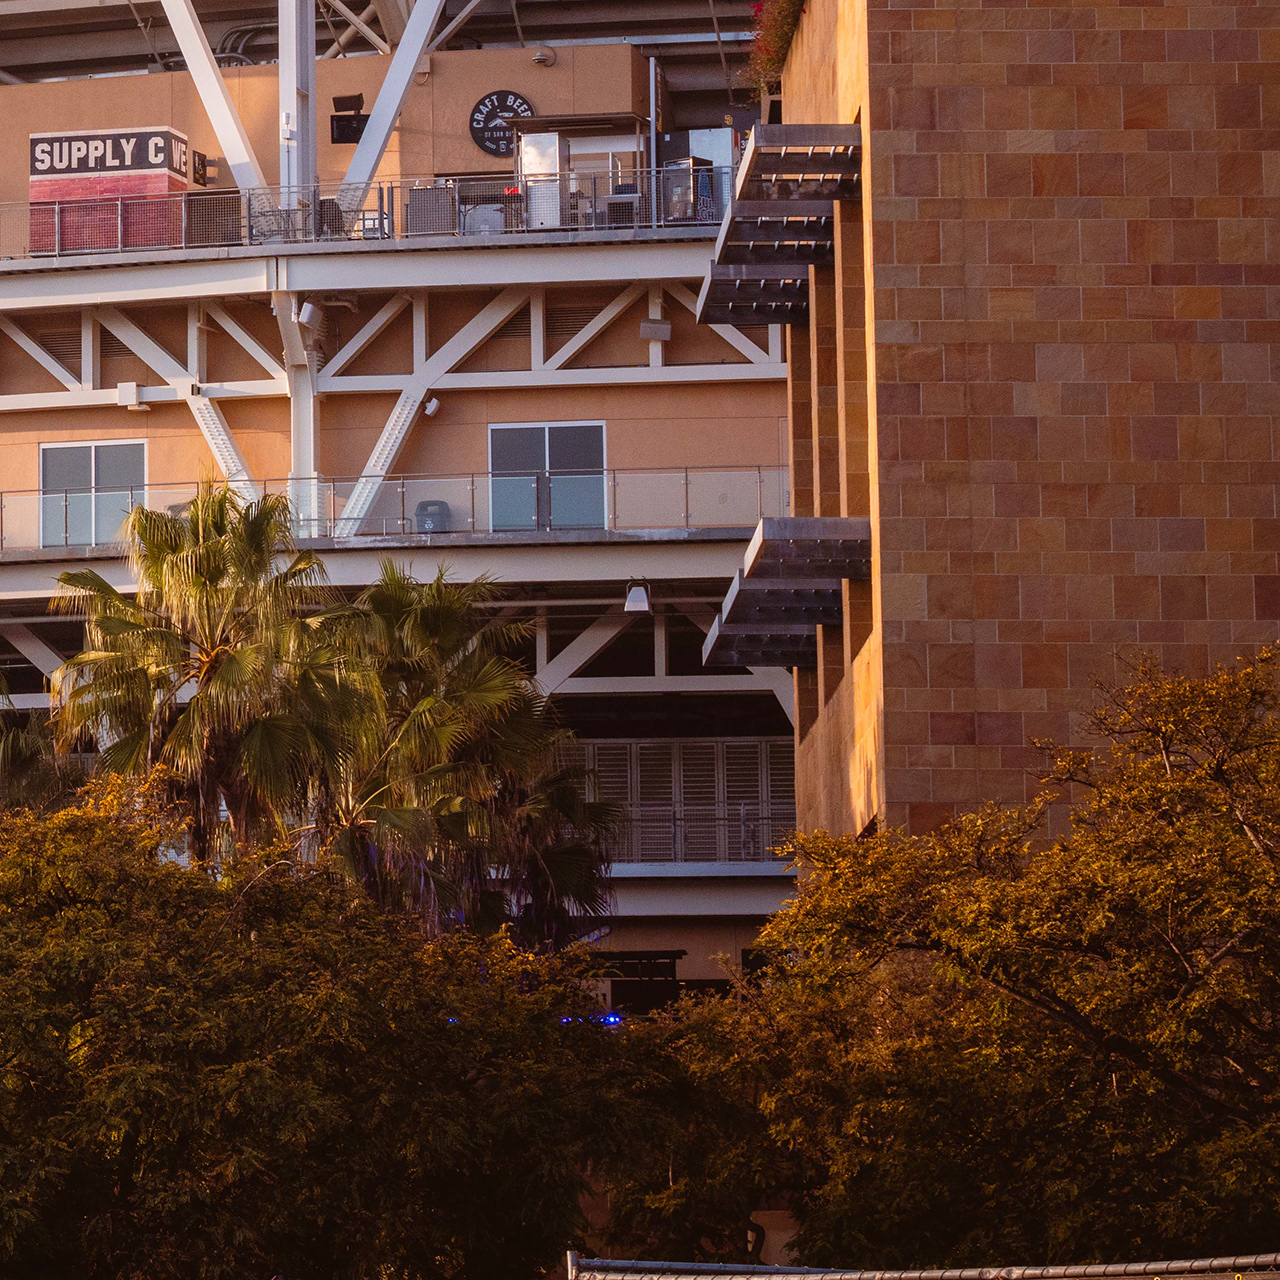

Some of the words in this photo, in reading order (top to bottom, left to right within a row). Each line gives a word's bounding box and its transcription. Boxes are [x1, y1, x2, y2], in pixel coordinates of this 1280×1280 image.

[472, 94, 499, 128] CRAFT
[34, 136, 136, 170] SUPPLY
[148, 136, 165, 164] C
[172, 138, 187, 173] WE
